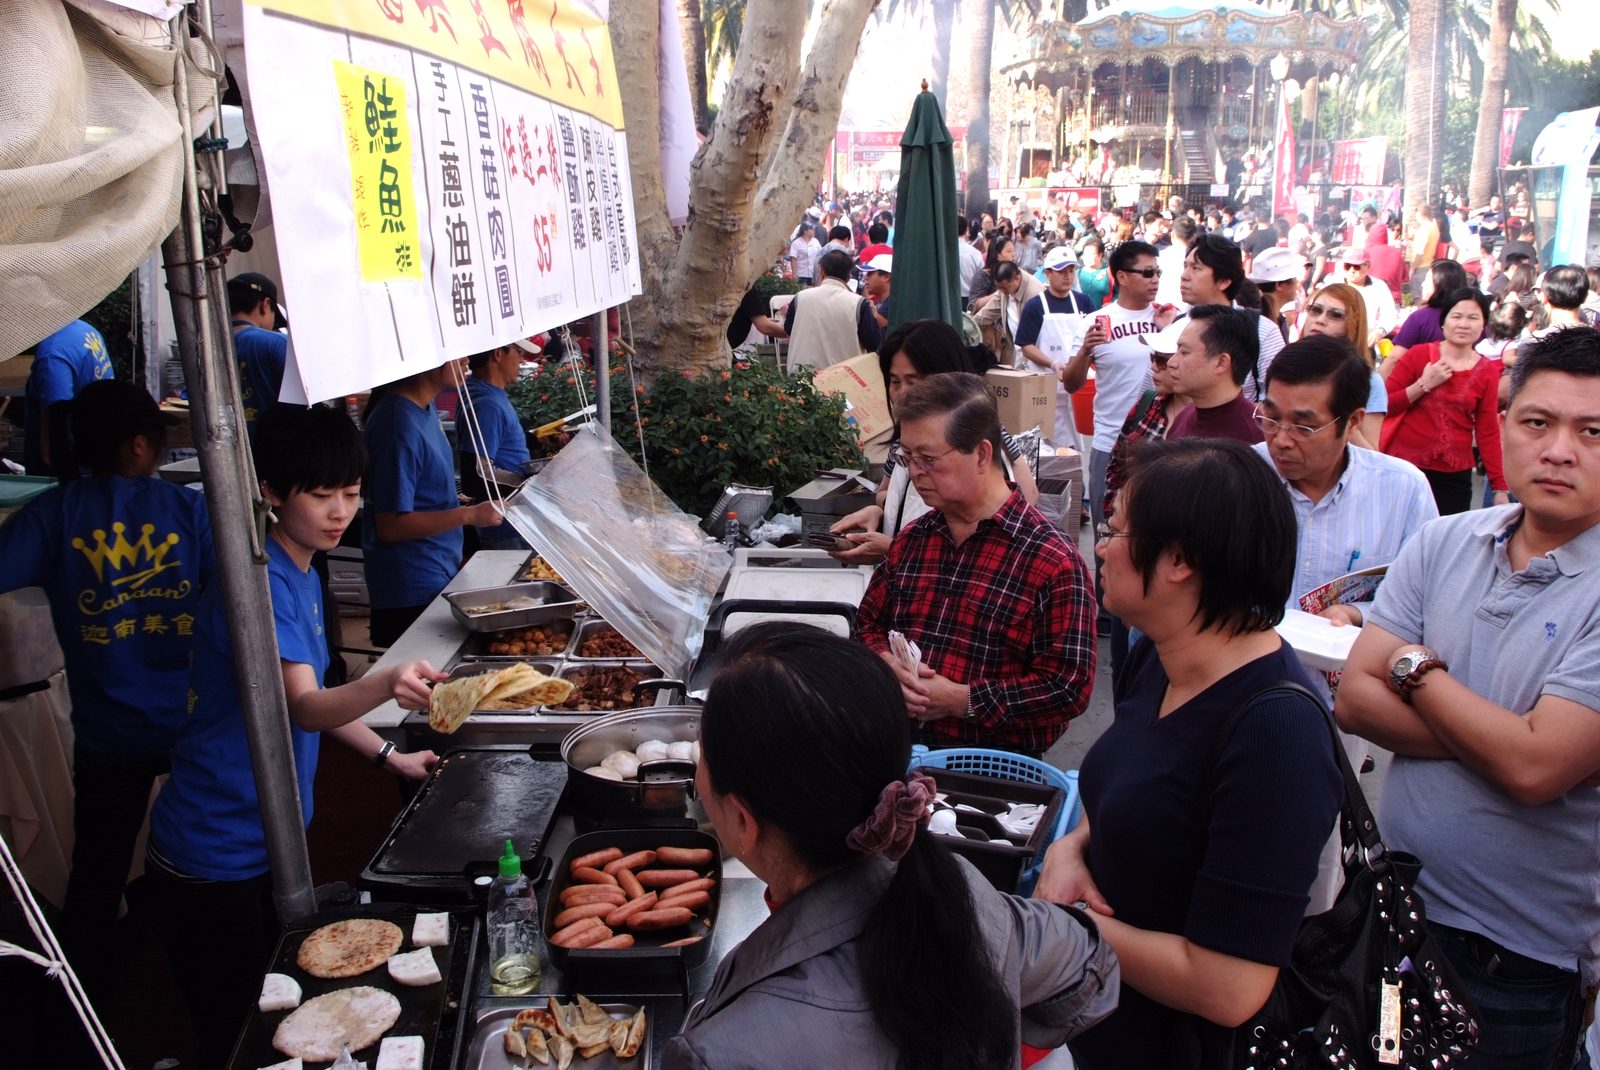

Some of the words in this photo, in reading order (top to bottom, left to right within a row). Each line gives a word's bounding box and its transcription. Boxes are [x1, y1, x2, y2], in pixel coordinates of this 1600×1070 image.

[78, 580, 191, 615] Canaan
[80, 613, 195, 645] 迦南美食
